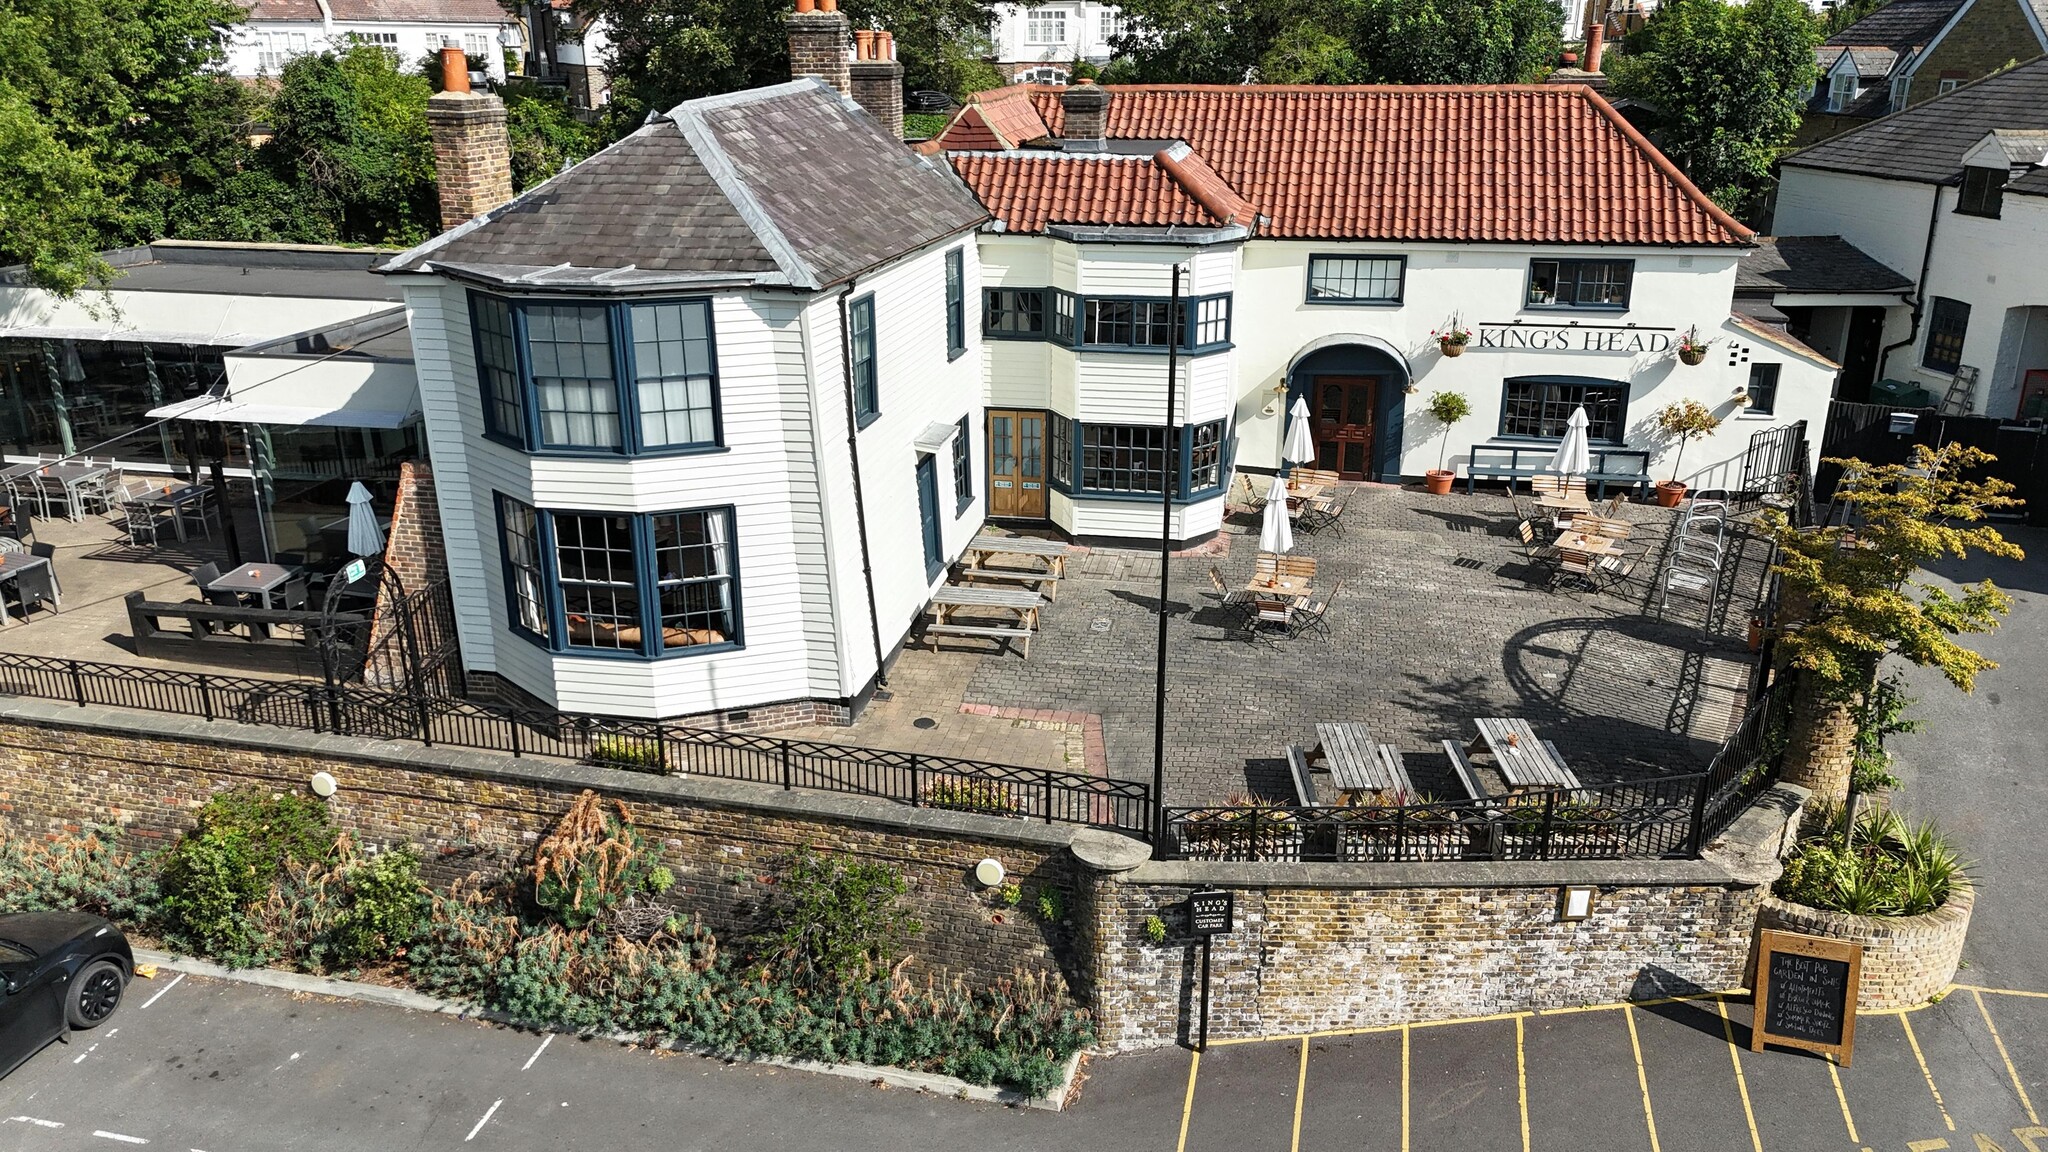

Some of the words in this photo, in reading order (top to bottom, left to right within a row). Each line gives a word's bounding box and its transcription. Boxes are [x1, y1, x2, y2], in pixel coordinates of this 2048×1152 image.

[1479, 328, 1570, 350] KING'S
[1583, 331, 1670, 352] HEAD
[1780, 956, 1793, 968] THE
[1795, 958, 1812, 972] BEST
[1814, 962, 1828, 974] PUB
[1773, 967, 1804, 981] GARDEN
[1809, 974, 1818, 983] IN
